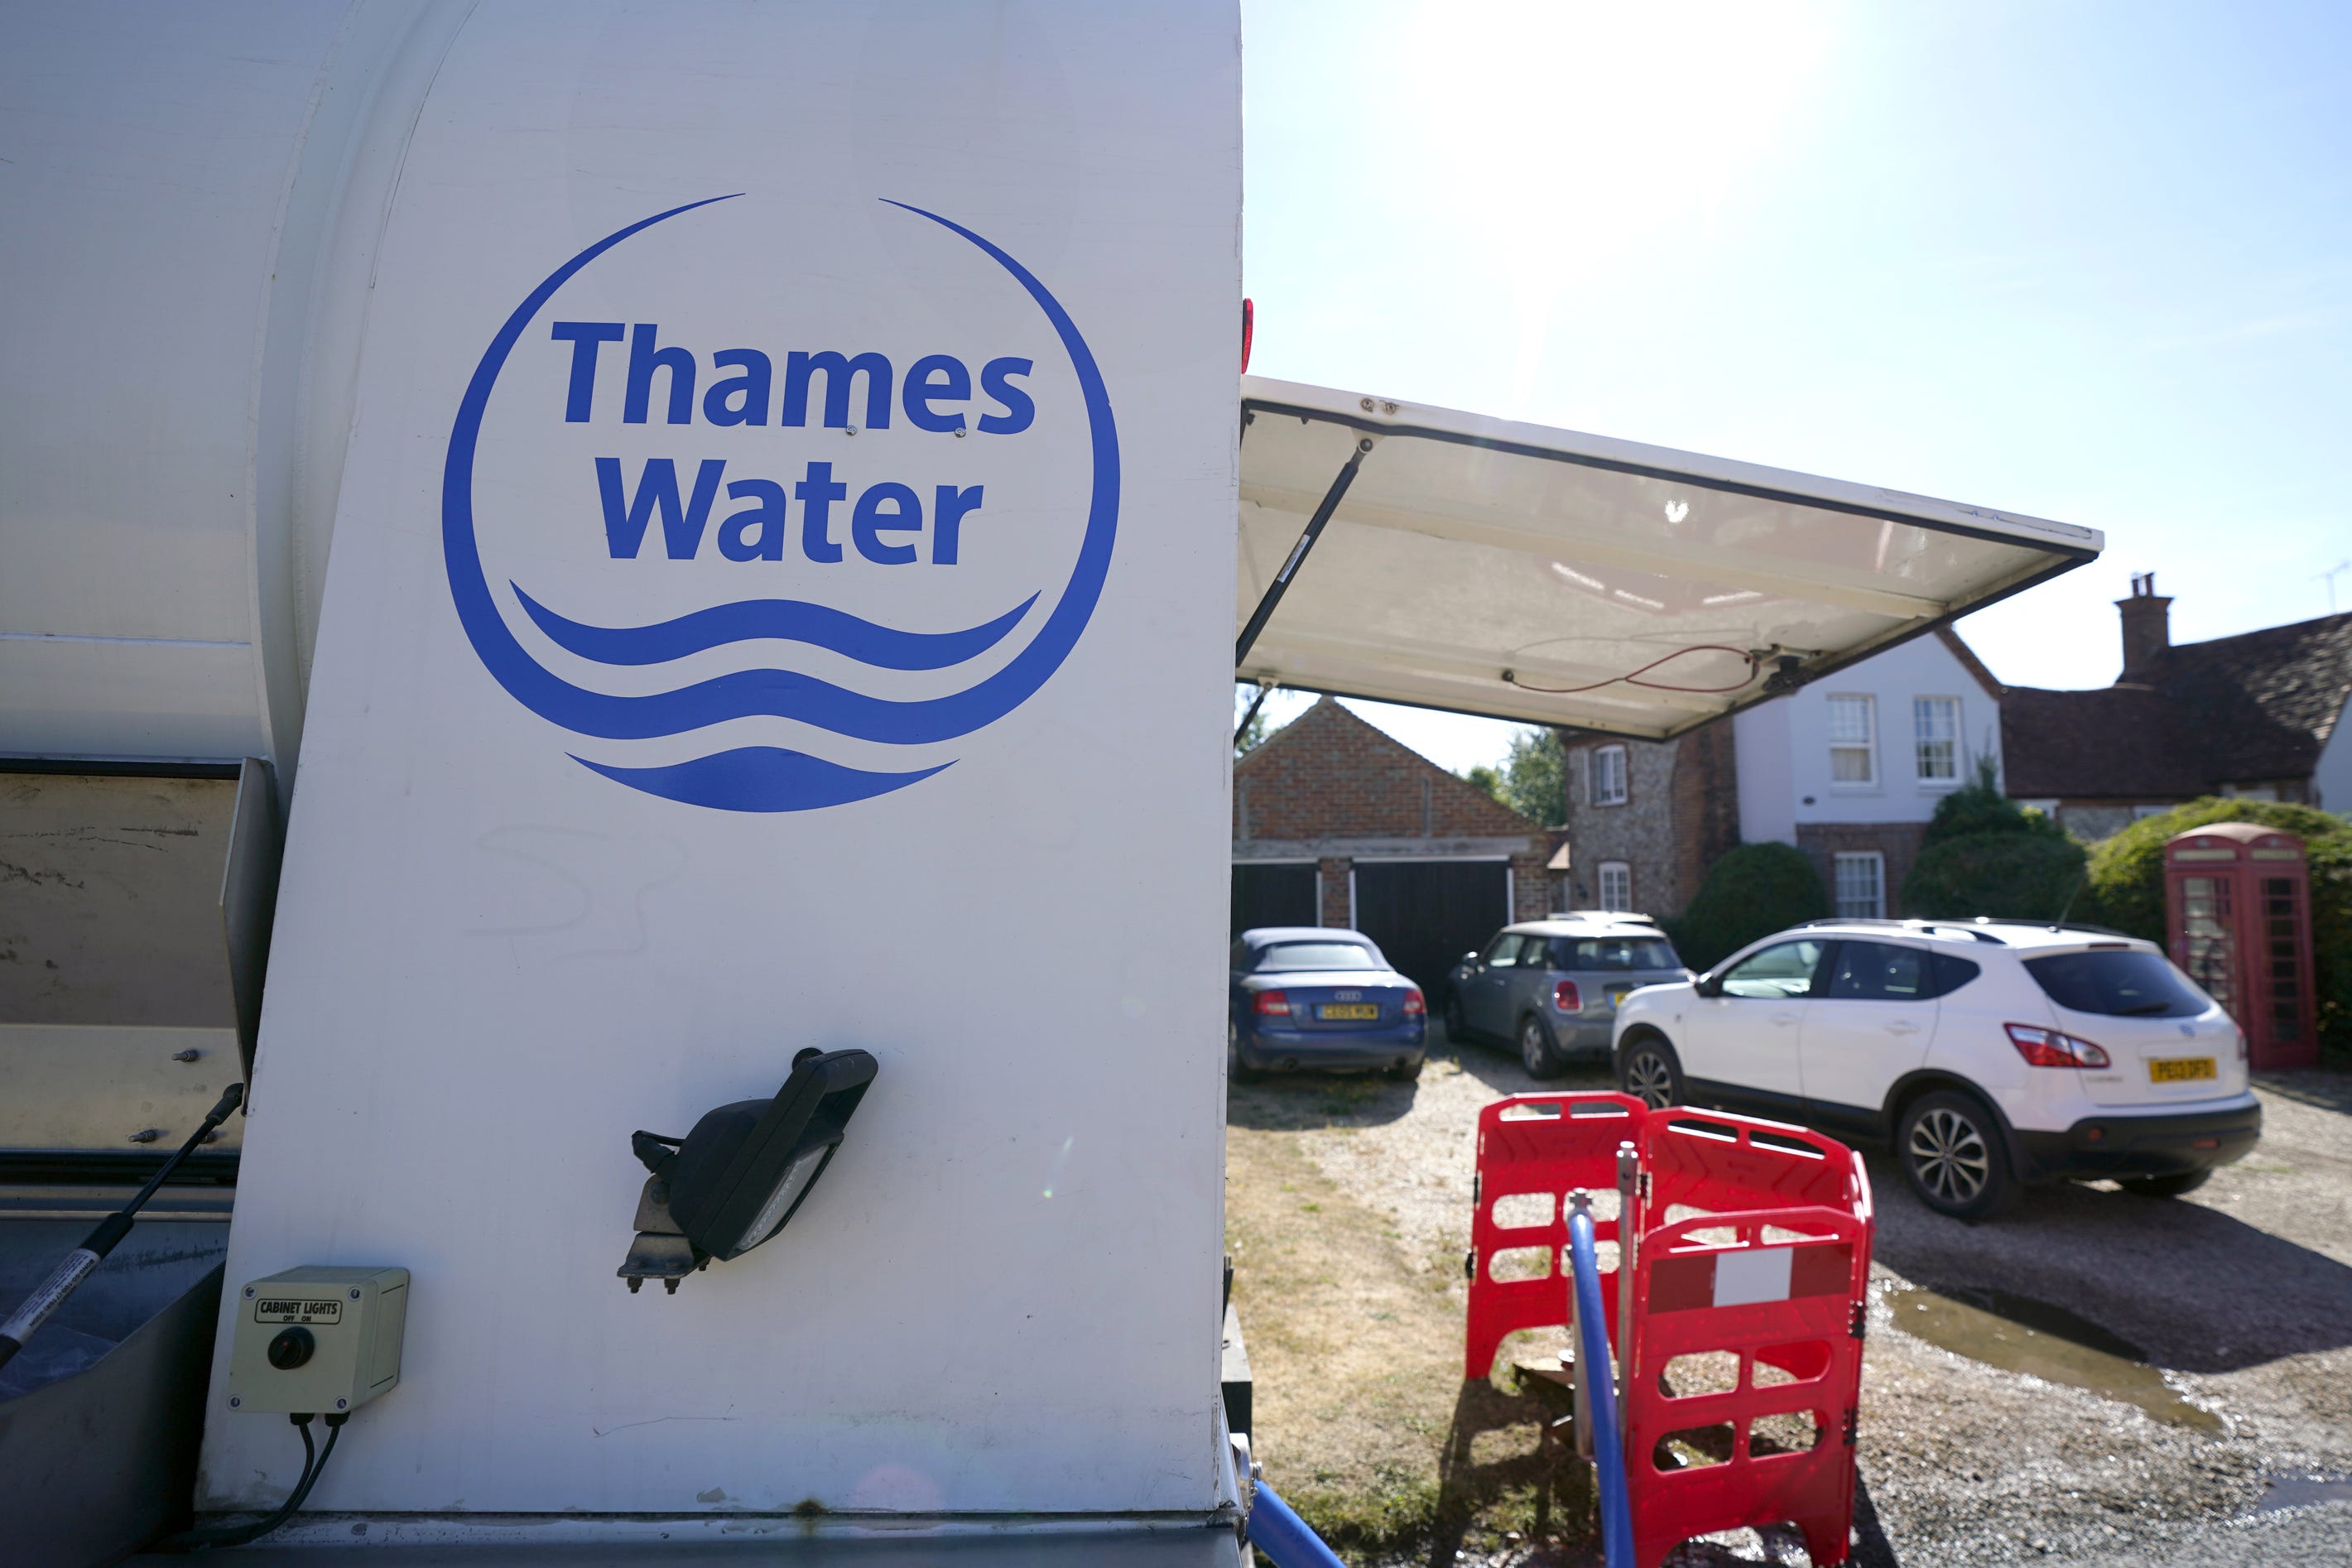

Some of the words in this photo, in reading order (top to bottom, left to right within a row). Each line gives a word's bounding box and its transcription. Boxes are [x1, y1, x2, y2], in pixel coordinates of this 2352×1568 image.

[551, 322, 1035, 434] Thames
[595, 458, 984, 565] Water
[260, 1301, 301, 1314] CABINET
[303, 1302, 338, 1315] LIGHTS
